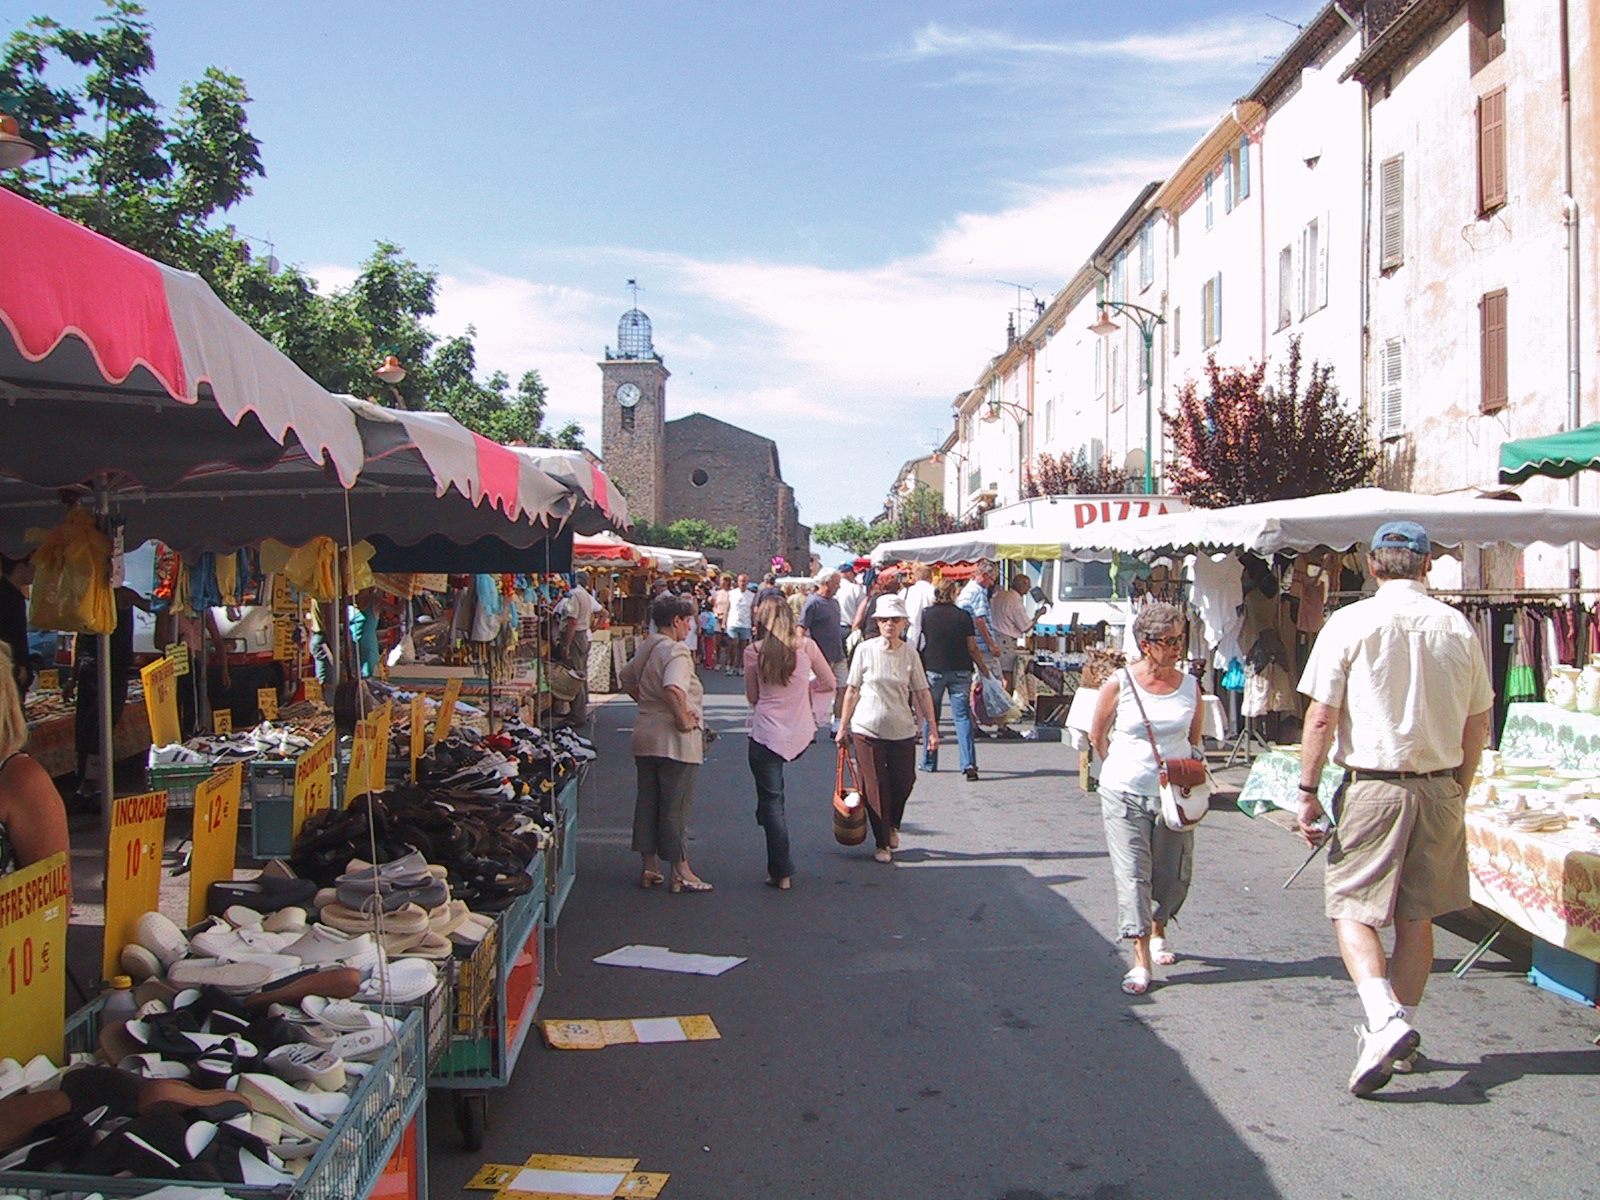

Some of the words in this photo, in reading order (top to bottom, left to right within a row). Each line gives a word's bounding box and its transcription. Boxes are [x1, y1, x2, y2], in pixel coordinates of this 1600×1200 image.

[115, 793, 167, 828] INCROYABLE
[207, 795, 222, 833] 12
[125, 838, 141, 880] 10
[25, 865, 68, 915] SPECIALE
[8, 937, 33, 995] 10
